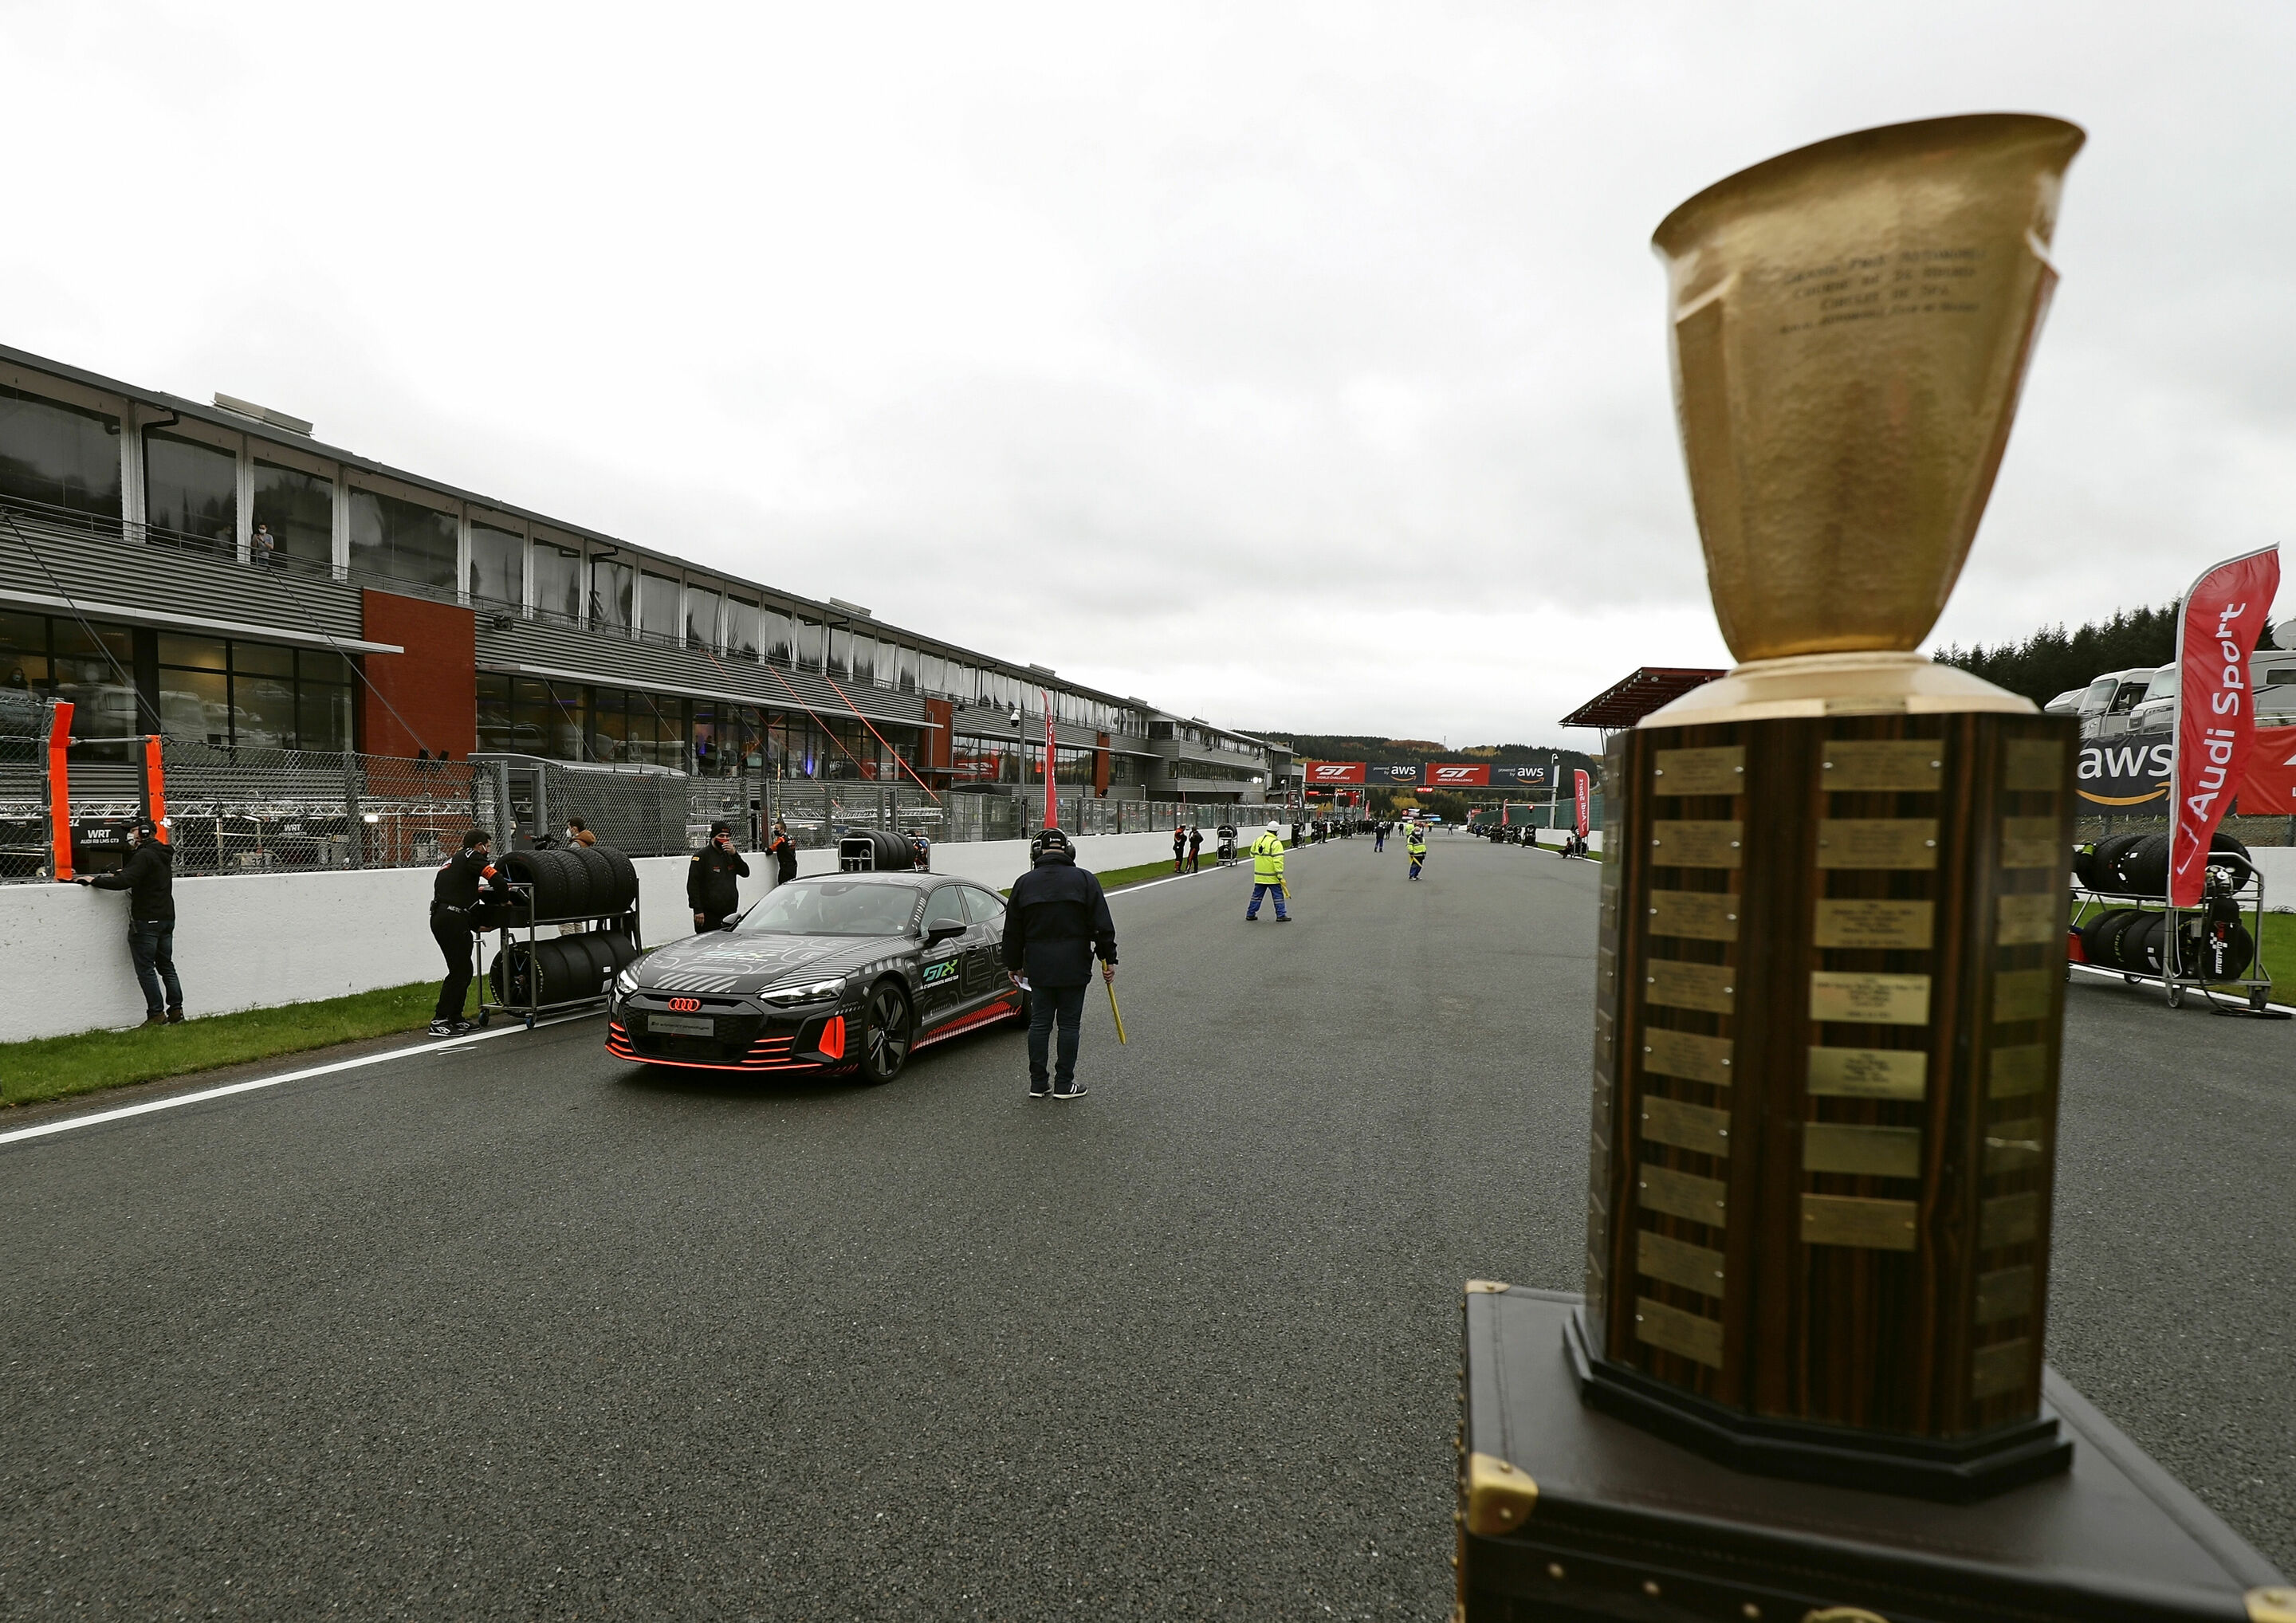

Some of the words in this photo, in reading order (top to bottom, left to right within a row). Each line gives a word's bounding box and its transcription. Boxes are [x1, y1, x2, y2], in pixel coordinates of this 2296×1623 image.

[2211, 603, 2247, 717] Sport
[2077, 744, 2175, 780] aws
[1315, 765, 1356, 776] GT
[1391, 765, 1417, 775] aws
[1436, 767, 1480, 778] GT
[1517, 767, 1544, 777] aws
[2188, 728, 2235, 823] Audi
[284, 823, 302, 832] WRT
[87, 829, 112, 839] WRT
[923, 958, 958, 982] GTX
